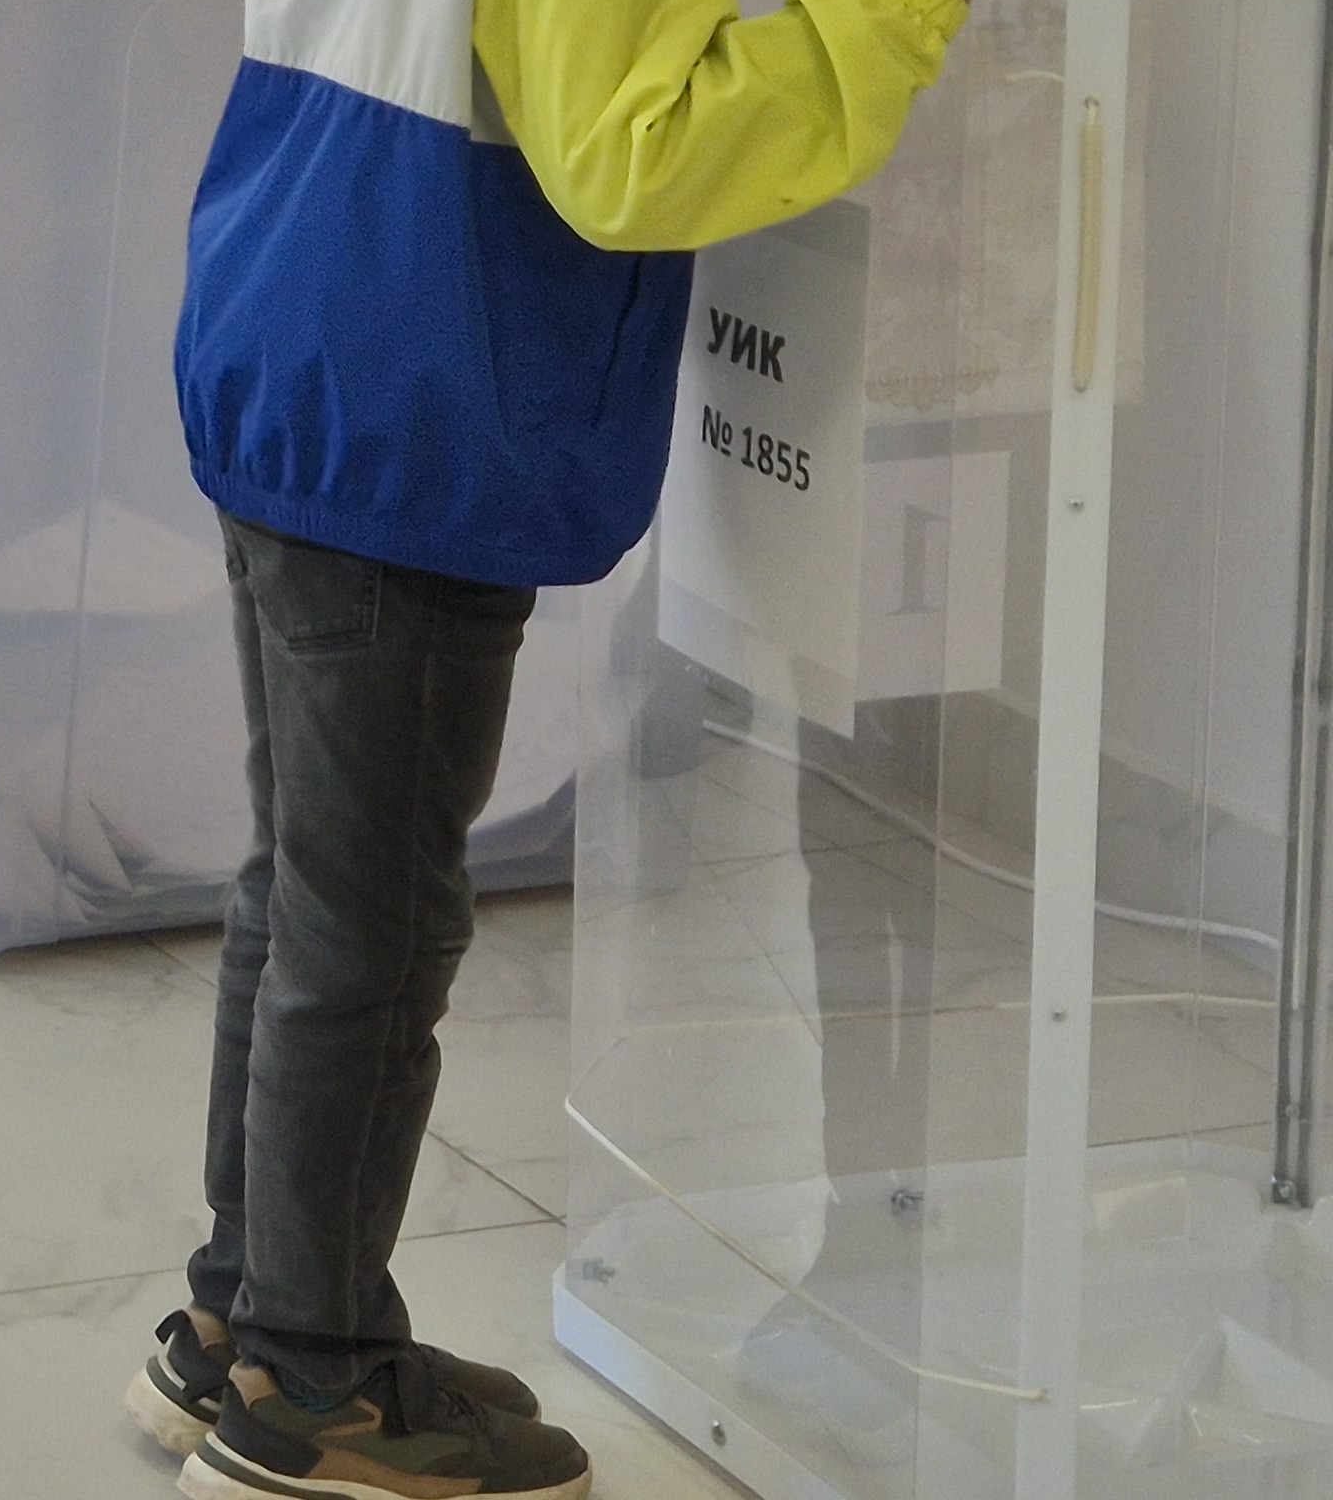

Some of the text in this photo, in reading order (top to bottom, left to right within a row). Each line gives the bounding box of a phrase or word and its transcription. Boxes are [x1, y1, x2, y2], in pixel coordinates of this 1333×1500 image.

[706, 305, 786, 384] УИК
[701, 403, 811, 492] № 1855
